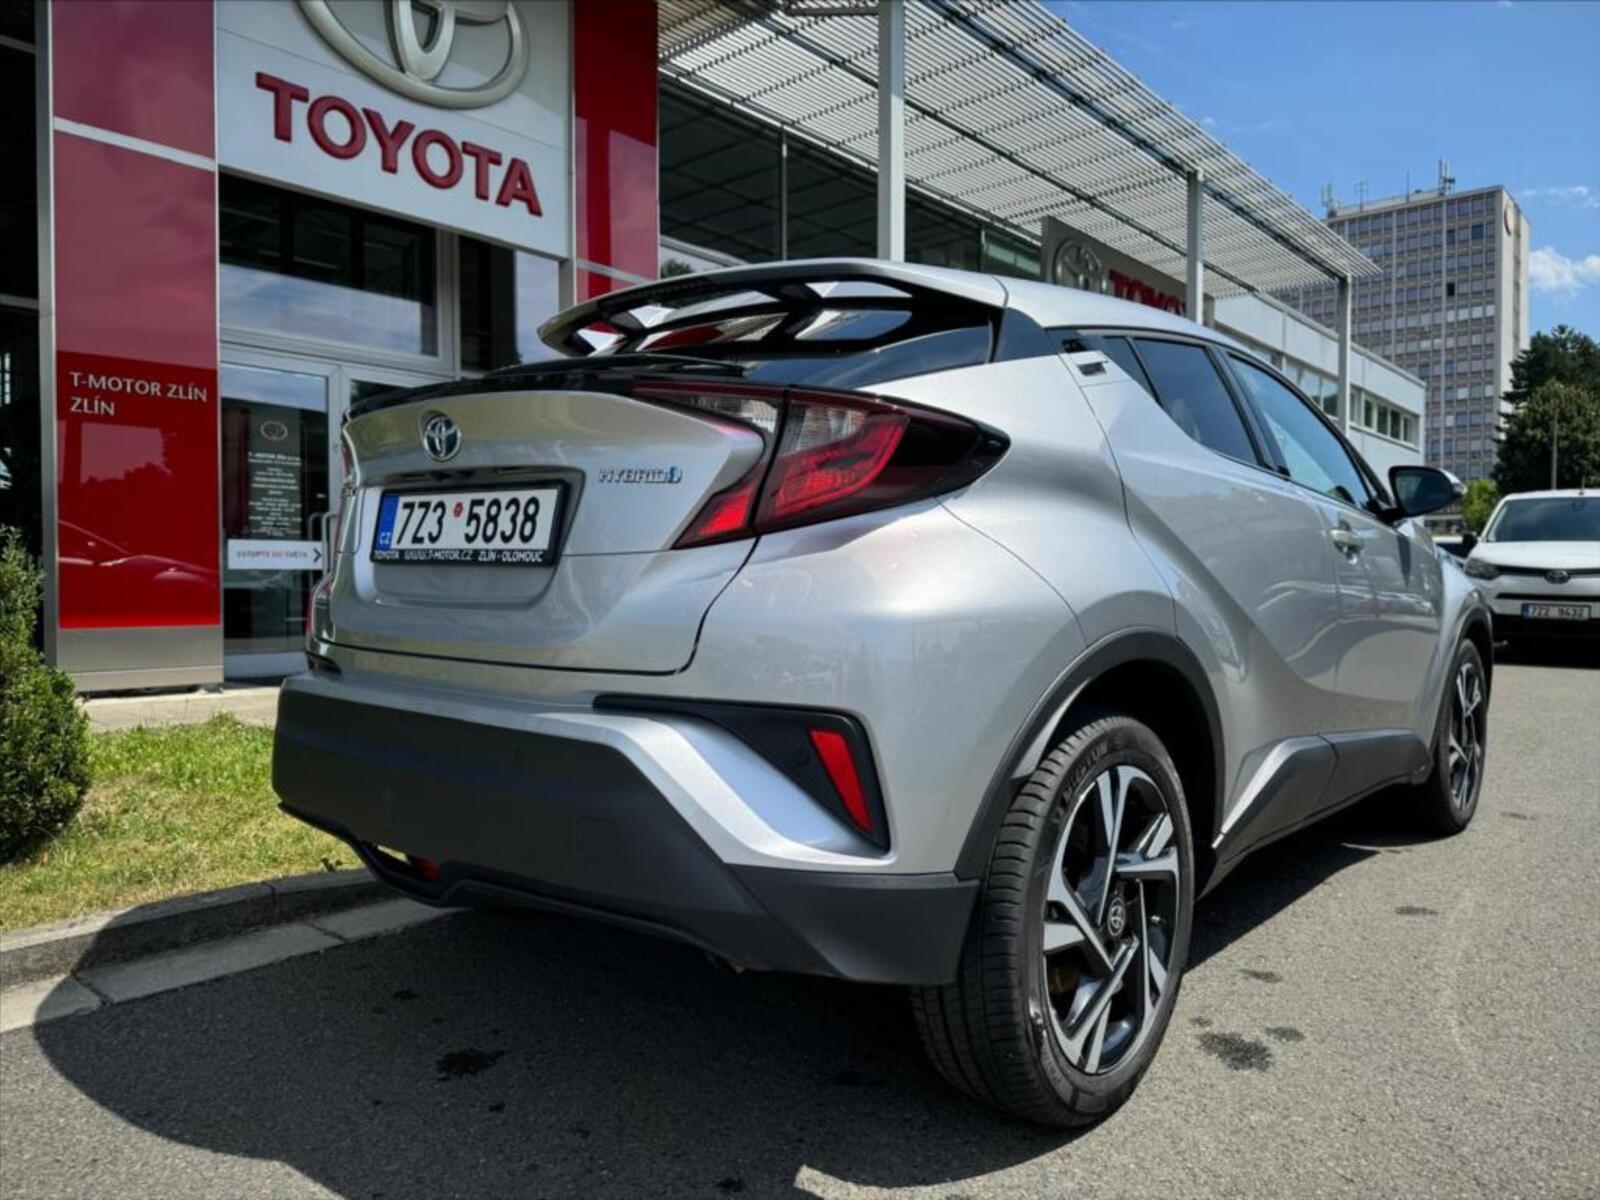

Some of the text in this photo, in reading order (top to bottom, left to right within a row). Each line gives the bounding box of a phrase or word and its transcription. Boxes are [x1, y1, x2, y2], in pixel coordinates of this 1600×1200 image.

[255, 71, 543, 217] TOYOTA
[1108, 268, 1187, 316] TOYO
[69, 371, 208, 403] T-MOTOR ZLÍN
[70, 395, 115, 416] ZLÍN
[598, 466, 669, 483] HYBRID
[396, 496, 541, 545] 7Z3 5838
[379, 532, 392, 546] CZ
[374, 549, 400, 560] TOYOTA
[502, 550, 544, 563] OLOMOUC
